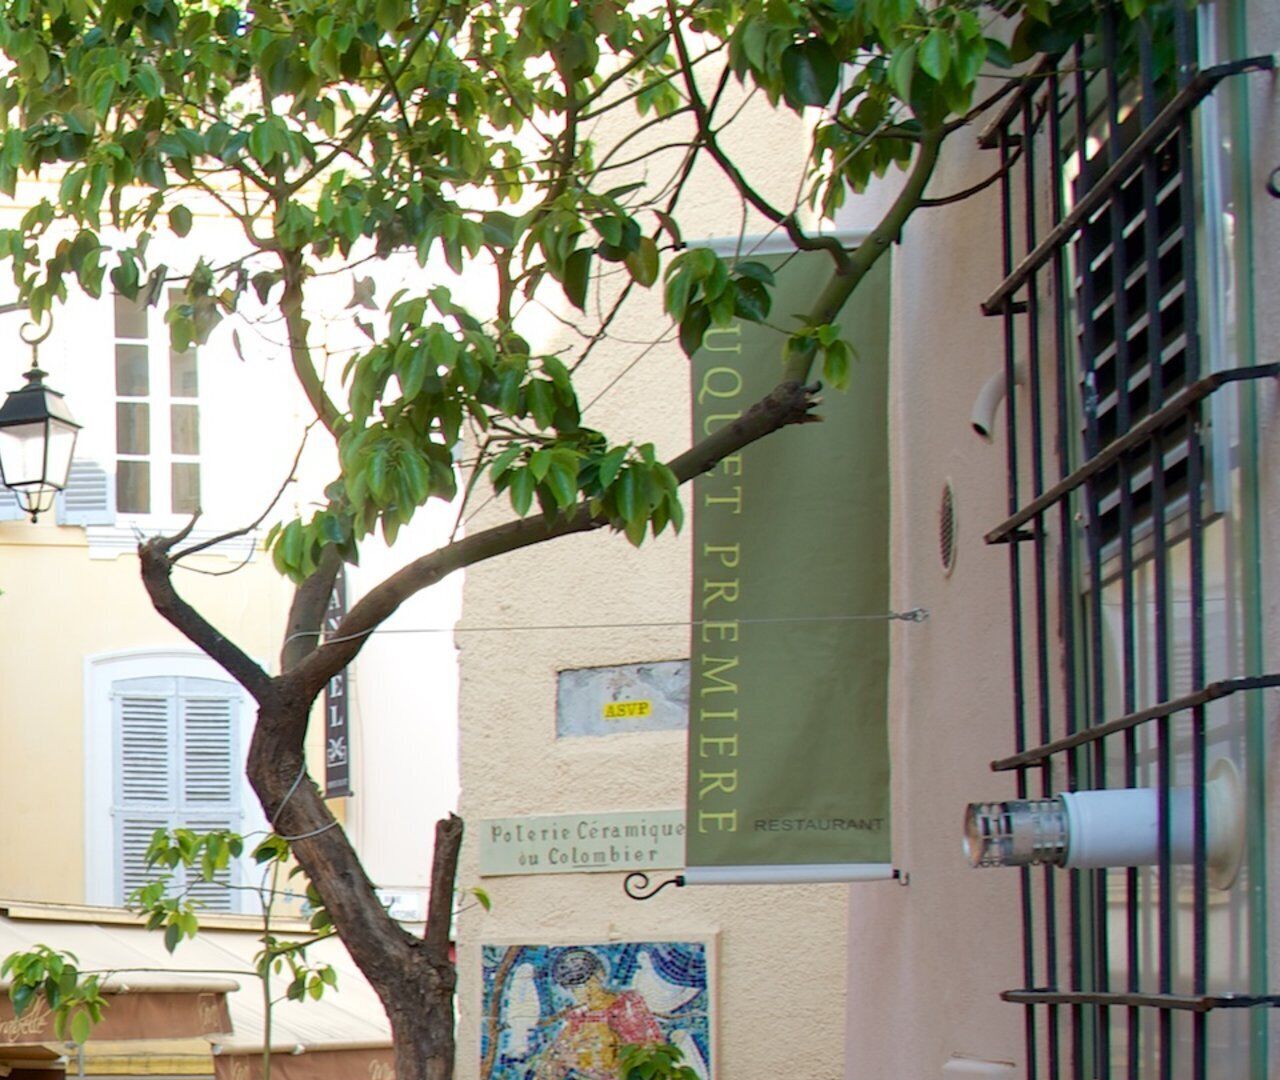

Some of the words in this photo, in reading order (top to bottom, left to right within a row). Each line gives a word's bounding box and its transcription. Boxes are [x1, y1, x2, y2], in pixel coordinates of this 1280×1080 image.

[698, 541, 741, 834] PREMIERE
[576, 819, 686, 844] Céramique
[753, 818, 885, 832] RESTAURANT
[548, 845, 659, 866] Colombier
